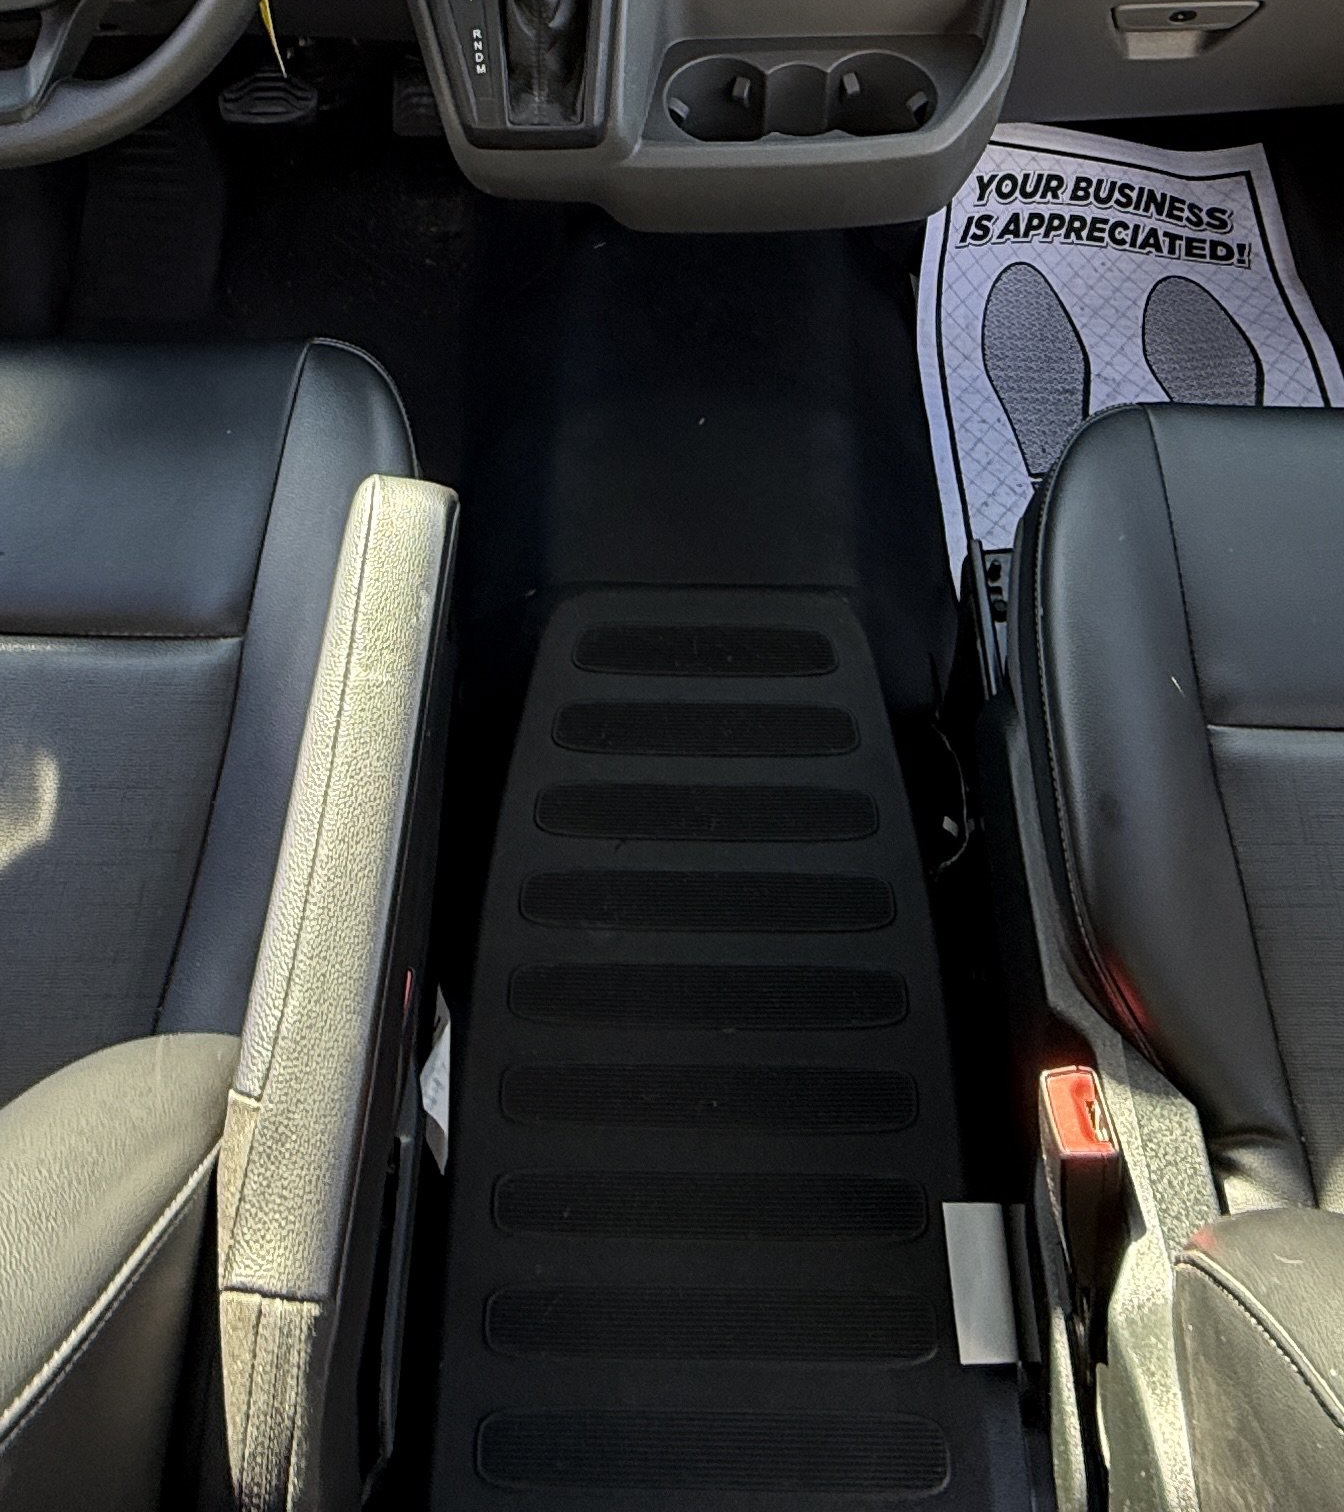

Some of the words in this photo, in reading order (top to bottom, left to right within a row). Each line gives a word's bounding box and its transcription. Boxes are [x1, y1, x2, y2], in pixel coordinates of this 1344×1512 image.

[472, 29, 483, 39] R
[473, 40, 483, 51] N
[475, 52, 484, 63] D
[476, 63, 487, 75] M
[973, 170, 1065, 205] YOUR
[1069, 175, 1233, 232] BUSINESS
[959, 213, 993, 244] IS
[996, 212, 1251, 266] APPRECIATED!
